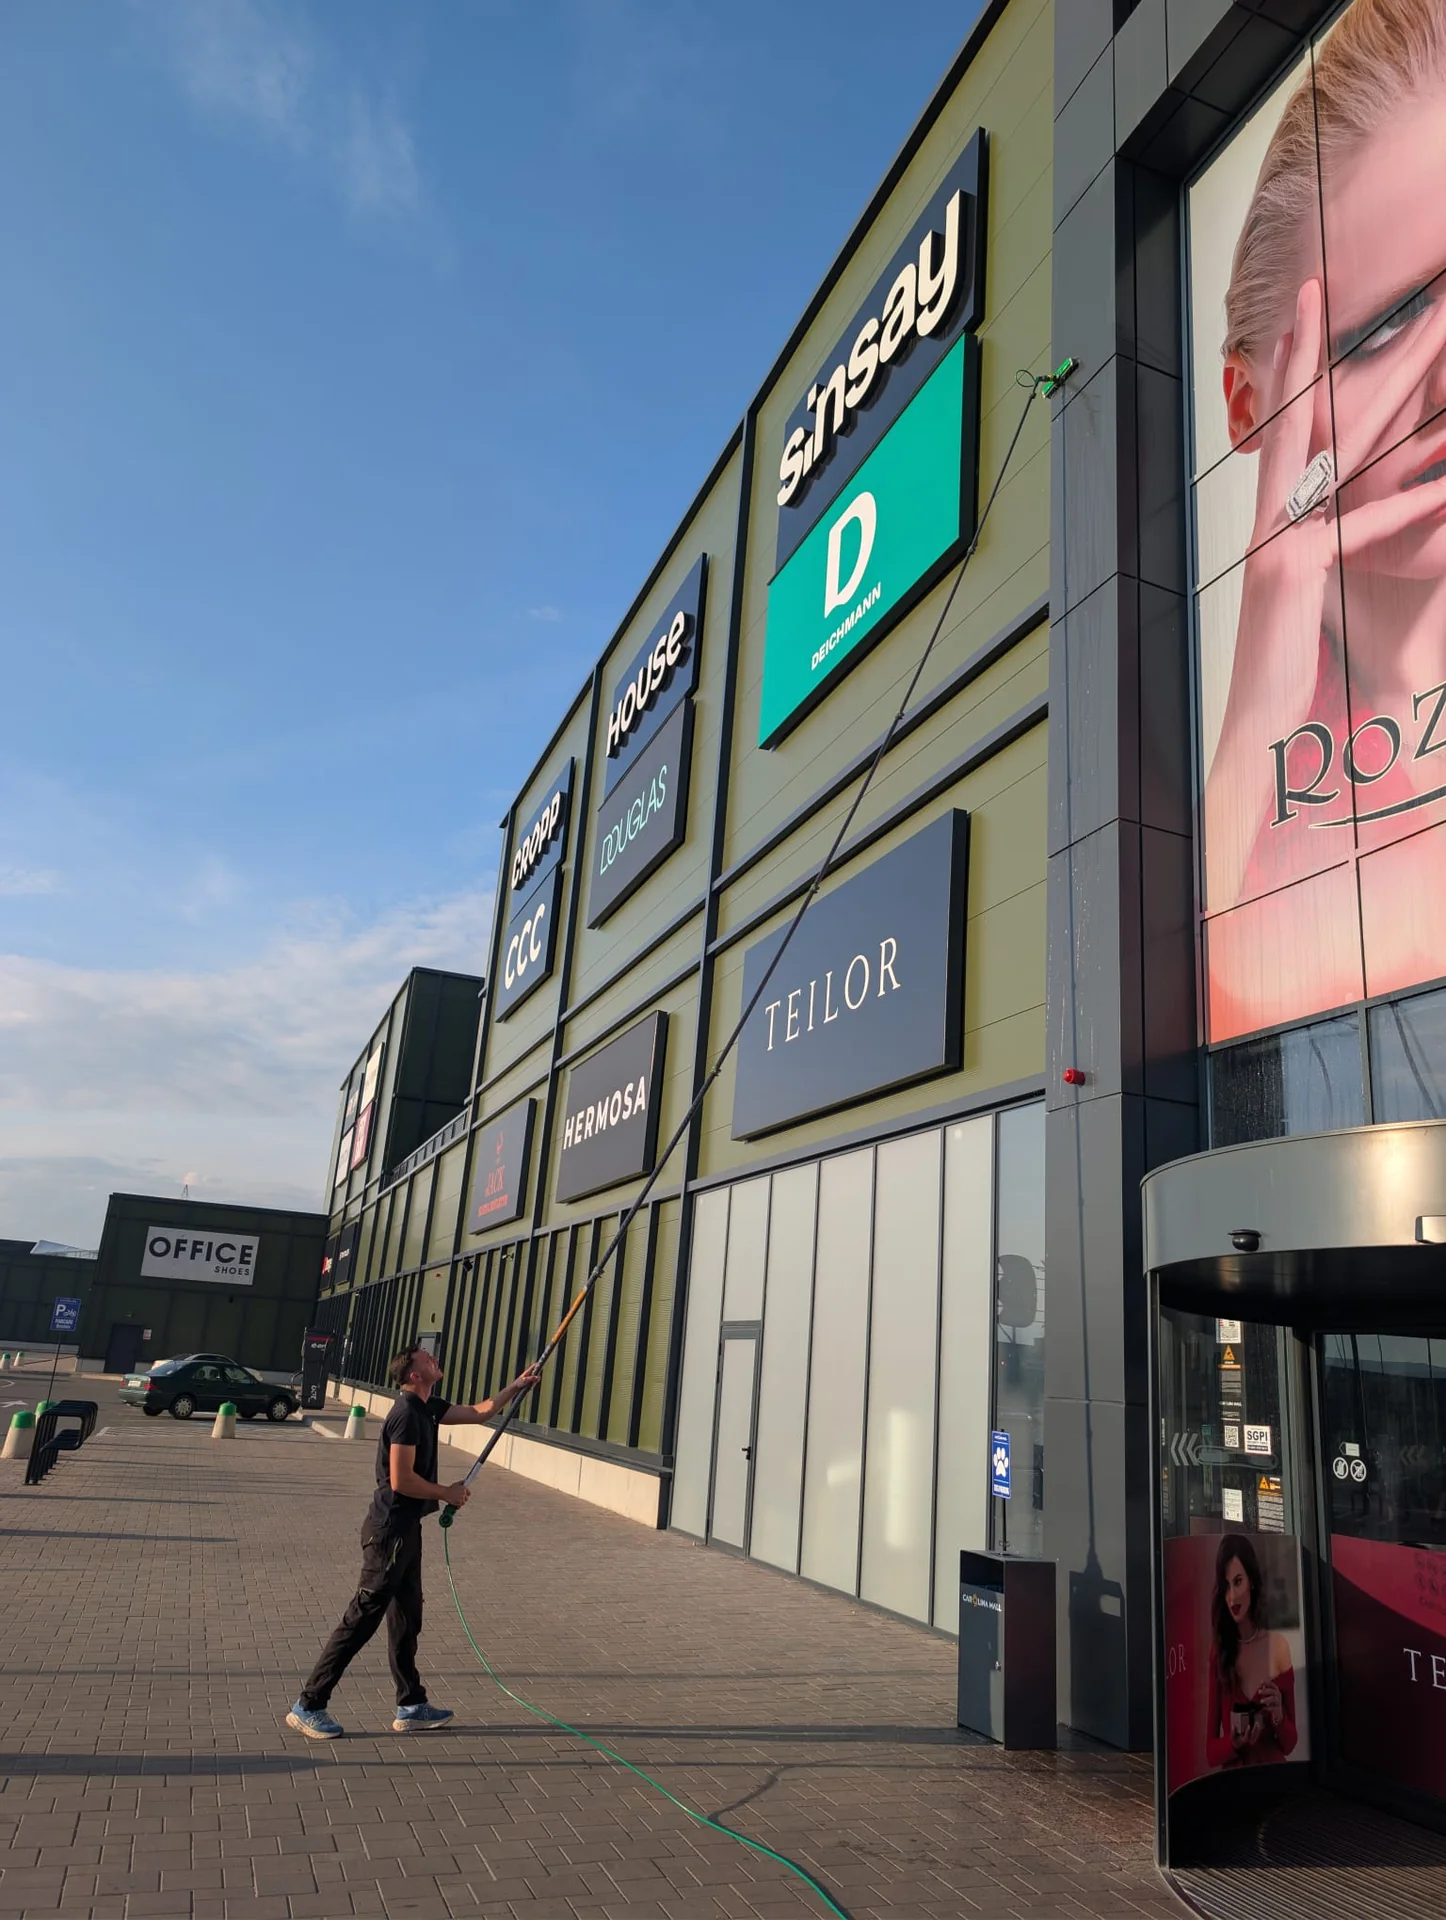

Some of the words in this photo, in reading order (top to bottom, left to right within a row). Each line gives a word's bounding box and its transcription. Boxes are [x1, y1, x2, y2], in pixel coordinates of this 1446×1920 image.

[777, 189, 961, 508] sinsay
[824, 491, 877, 619] D
[811, 581, 882, 670] DEICHMANN
[511, 790, 561, 890] CROPP
[600, 765, 668, 875] DOUGLAS
[504, 902, 547, 991] CCC
[764, 937, 901, 1052] TEILOR
[563, 1075, 647, 1151] HERMOSA
[148, 1236, 254, 1266] OFFICE
[213, 1265, 251, 1277] SHOES
[55, 1304, 66, 1316] P
[1246, 1430, 1268, 1442] SGPI
